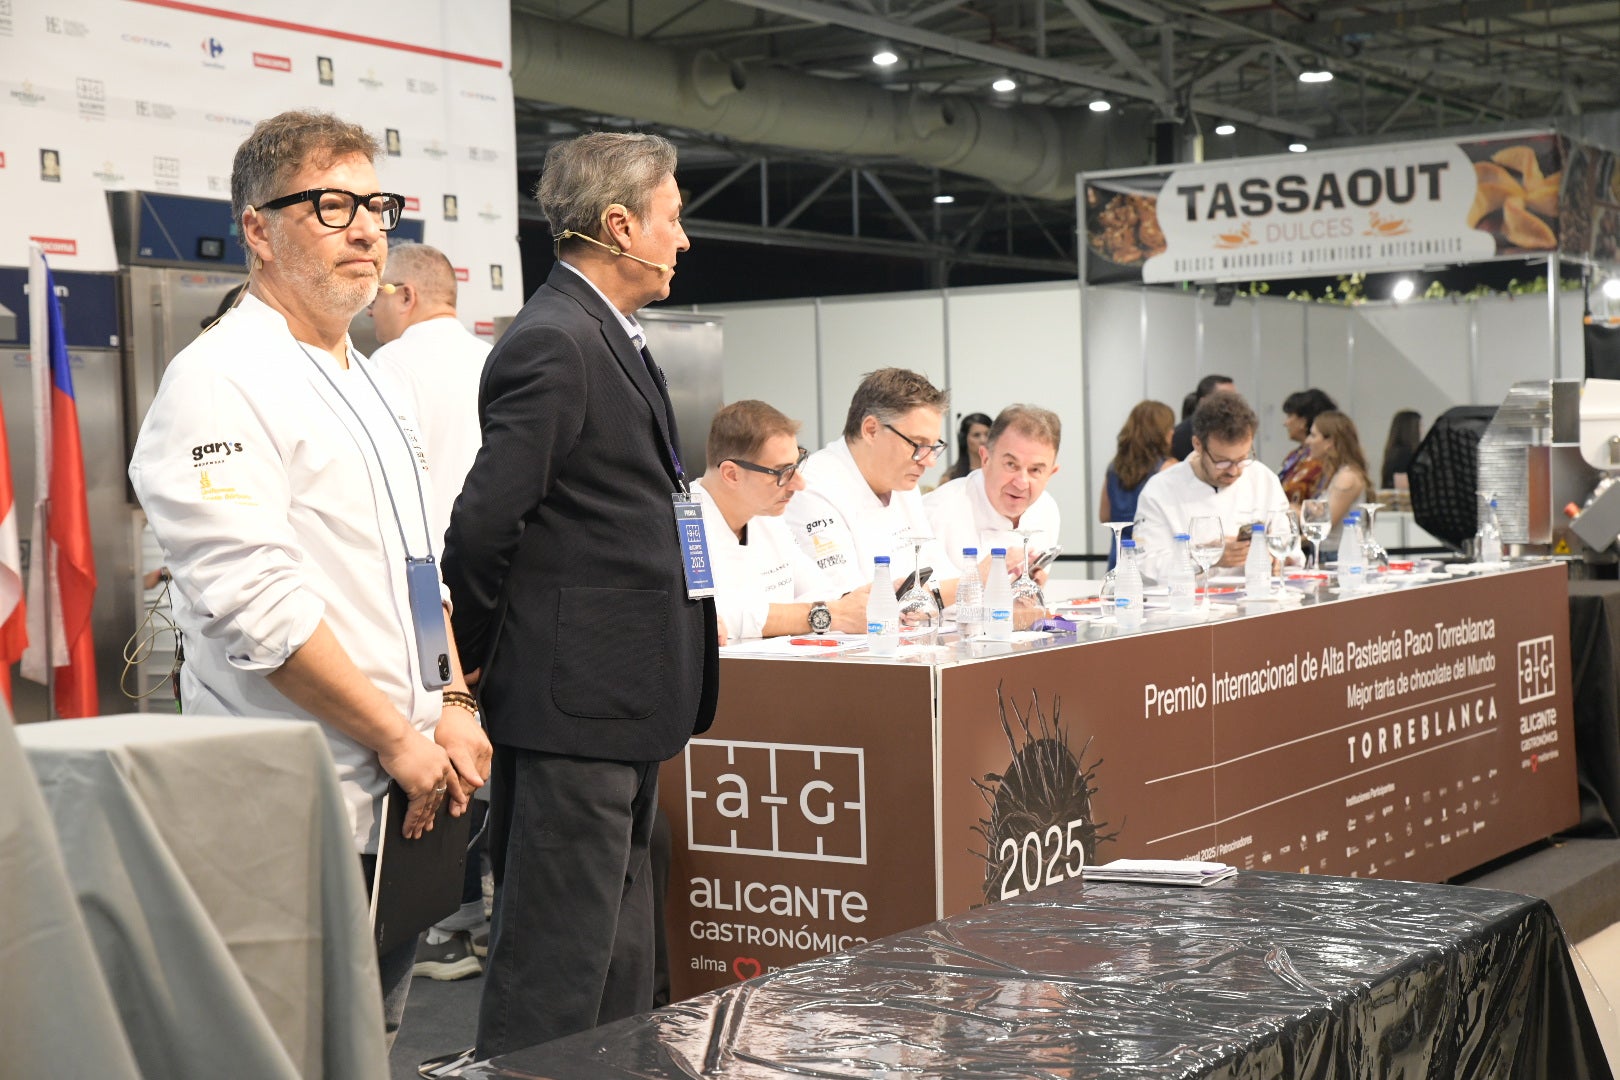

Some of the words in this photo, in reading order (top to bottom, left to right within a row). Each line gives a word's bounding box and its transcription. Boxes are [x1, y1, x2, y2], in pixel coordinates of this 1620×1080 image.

[1177, 162, 1449, 221] TASSAOUT
[1266, 218, 1353, 243] DULCES
[1175, 257, 1214, 273] DULCES
[1145, 676, 1207, 719] Premio
[1212, 654, 1297, 705] Internacional
[1301, 652, 1318, 683] de
[1320, 646, 1344, 678] Alta
[1347, 630, 1402, 671] Pastelería
[1405, 628, 1433, 657] Paco
[1435, 617, 1495, 651] Torreblanca
[1347, 684, 1373, 710] Mejor
[1374, 676, 1395, 701] tarta
[1397, 673, 1409, 695] de
[1410, 664, 1452, 691] chocolate
[1453, 657, 1467, 680] del
[1467, 651, 1496, 676] Mundo
[1348, 696, 1497, 763] TORREBLANCA
[1000, 818, 1085, 900] 2025
[1200, 846, 1216, 861] 2025
[691, 955, 727, 973] alma
